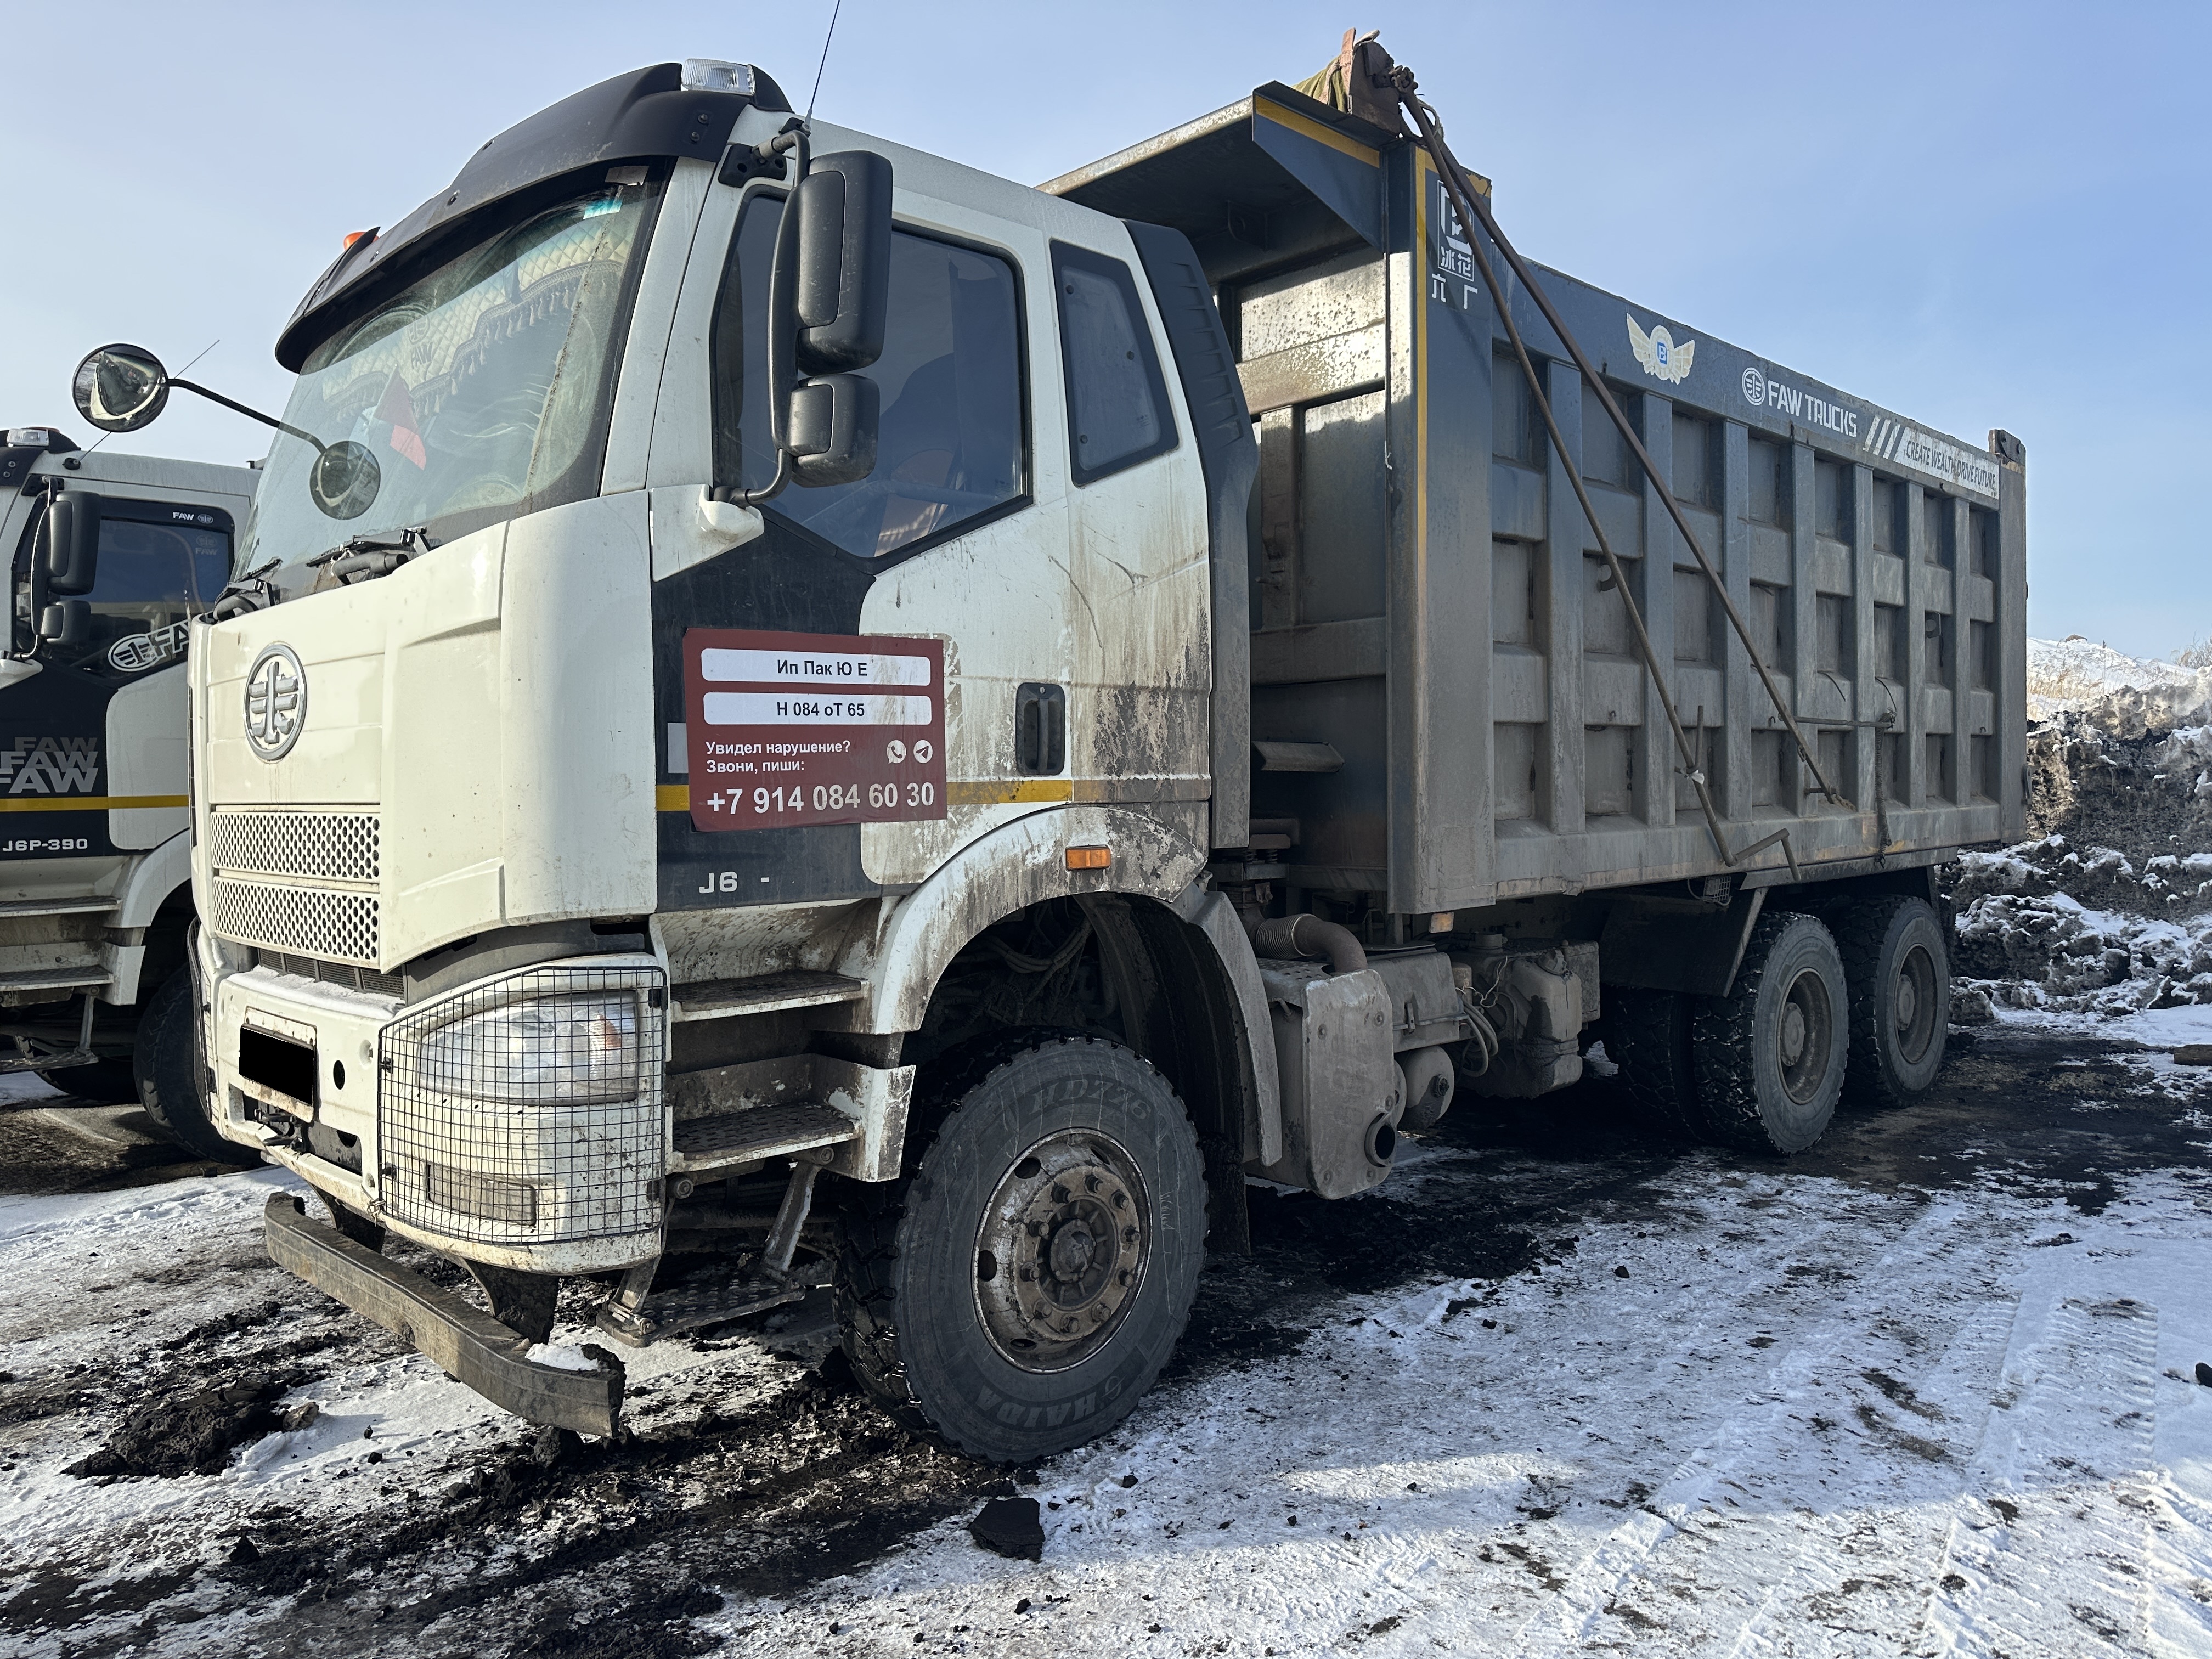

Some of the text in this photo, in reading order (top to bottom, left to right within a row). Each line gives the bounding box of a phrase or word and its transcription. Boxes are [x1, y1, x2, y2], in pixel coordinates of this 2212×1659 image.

[411, 342, 433, 369] FAW
[1768, 380, 1857, 438] FAW TRUCKS
[1906, 440, 1931, 466] CREATE
[1932, 449, 1956, 475] WEALTH
[1957, 460, 1974, 482] DRIVE
[172, 511, 194, 521] FAW
[195, 547, 218, 556] FAW
[777, 659, 867, 676] Ип Пак Ю Е
[777, 702, 865, 716] Н 084 оТ 65
[15, 737, 97, 755] FAW
[706, 740, 851, 756] Увидел нарушение?
[1, 751, 98, 772] FAW
[706, 759, 804, 774] Звони, пиши:
[707, 782, 934, 815] +7 914 084 60 30
[2, 838, 88, 851] J6P-390
[1029, 1078, 1152, 1120] HD776
[975, 1385, 1096, 1428] HAIDA
